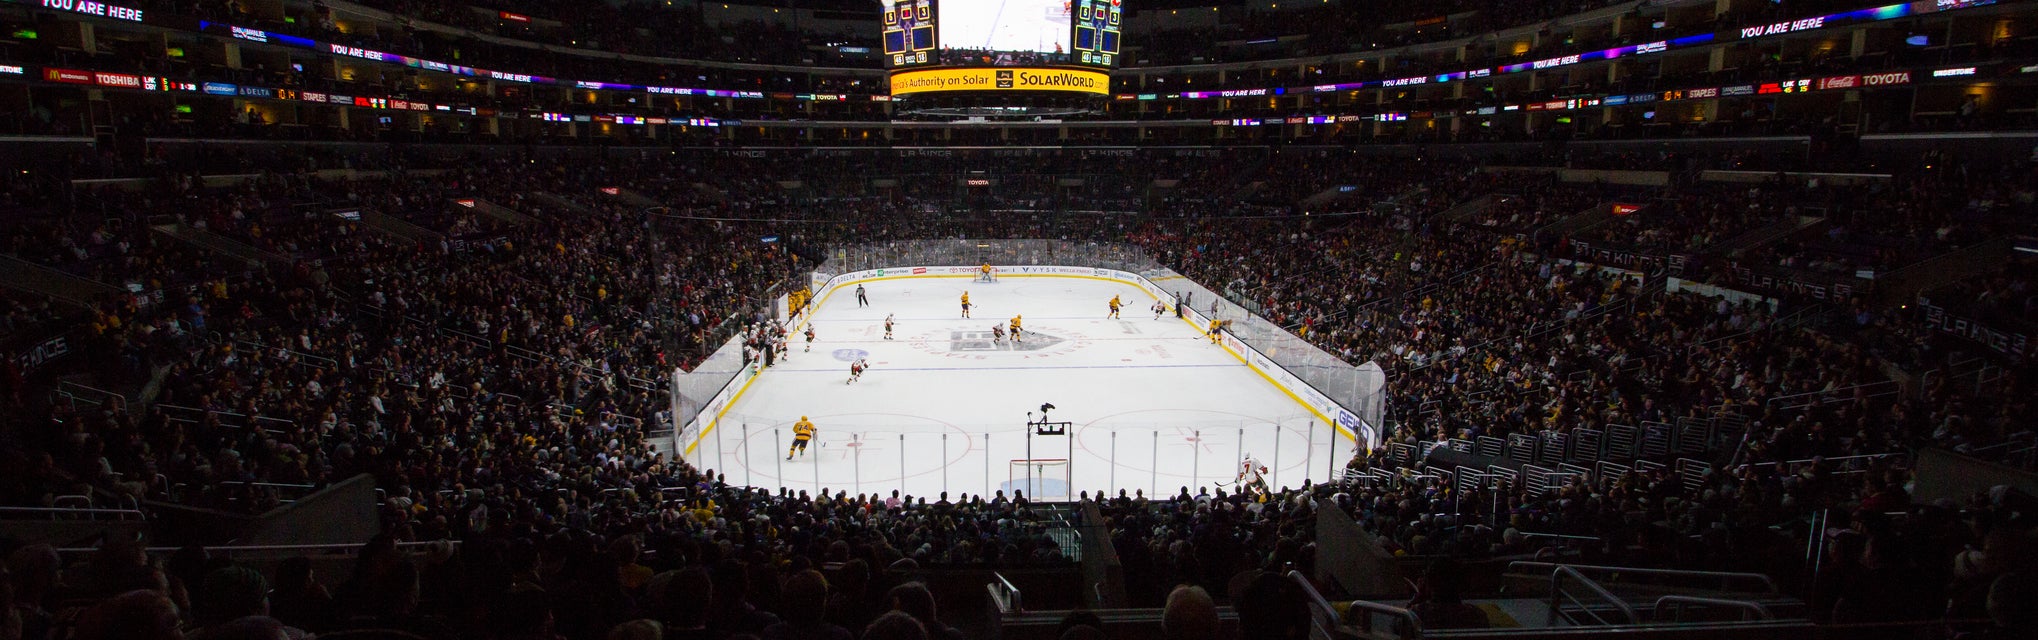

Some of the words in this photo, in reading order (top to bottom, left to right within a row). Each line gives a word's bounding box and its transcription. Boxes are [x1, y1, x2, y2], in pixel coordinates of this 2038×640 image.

[76, 0, 105, 16] ARE
[107, 5, 143, 21] HERE
[1741, 26, 1763, 38] YOU
[1765, 22, 1788, 35] ARE
[1790, 17, 1824, 32] HERE
[331, 44, 347, 54] YOU
[348, 48, 363, 57] ARE
[364, 50, 383, 61] HERE
[1533, 60, 1546, 69] YOU
[1547, 57, 1560, 67] ARE
[1561, 55, 1580, 65] HERE
[96, 74, 140, 86] TOSHIBA
[491, 71, 503, 79] YOU
[514, 74, 531, 82] HERE
[909, 76, 945, 88] Authority
[948, 77, 960, 85] on
[963, 74, 989, 85] Solar
[1395, 78, 1408, 86] ARE
[1863, 72, 1910, 85] TOYOTA
[247, 87, 270, 96] DELTA
[303, 92, 327, 102] STAPLES
[1235, 89, 1248, 97] ARE
[1689, 89, 1716, 98] STAPLES
[410, 102, 429, 111] TOYOTA
[840, 274, 856, 282] DELTA
[1244, 463, 1250, 474] 7
